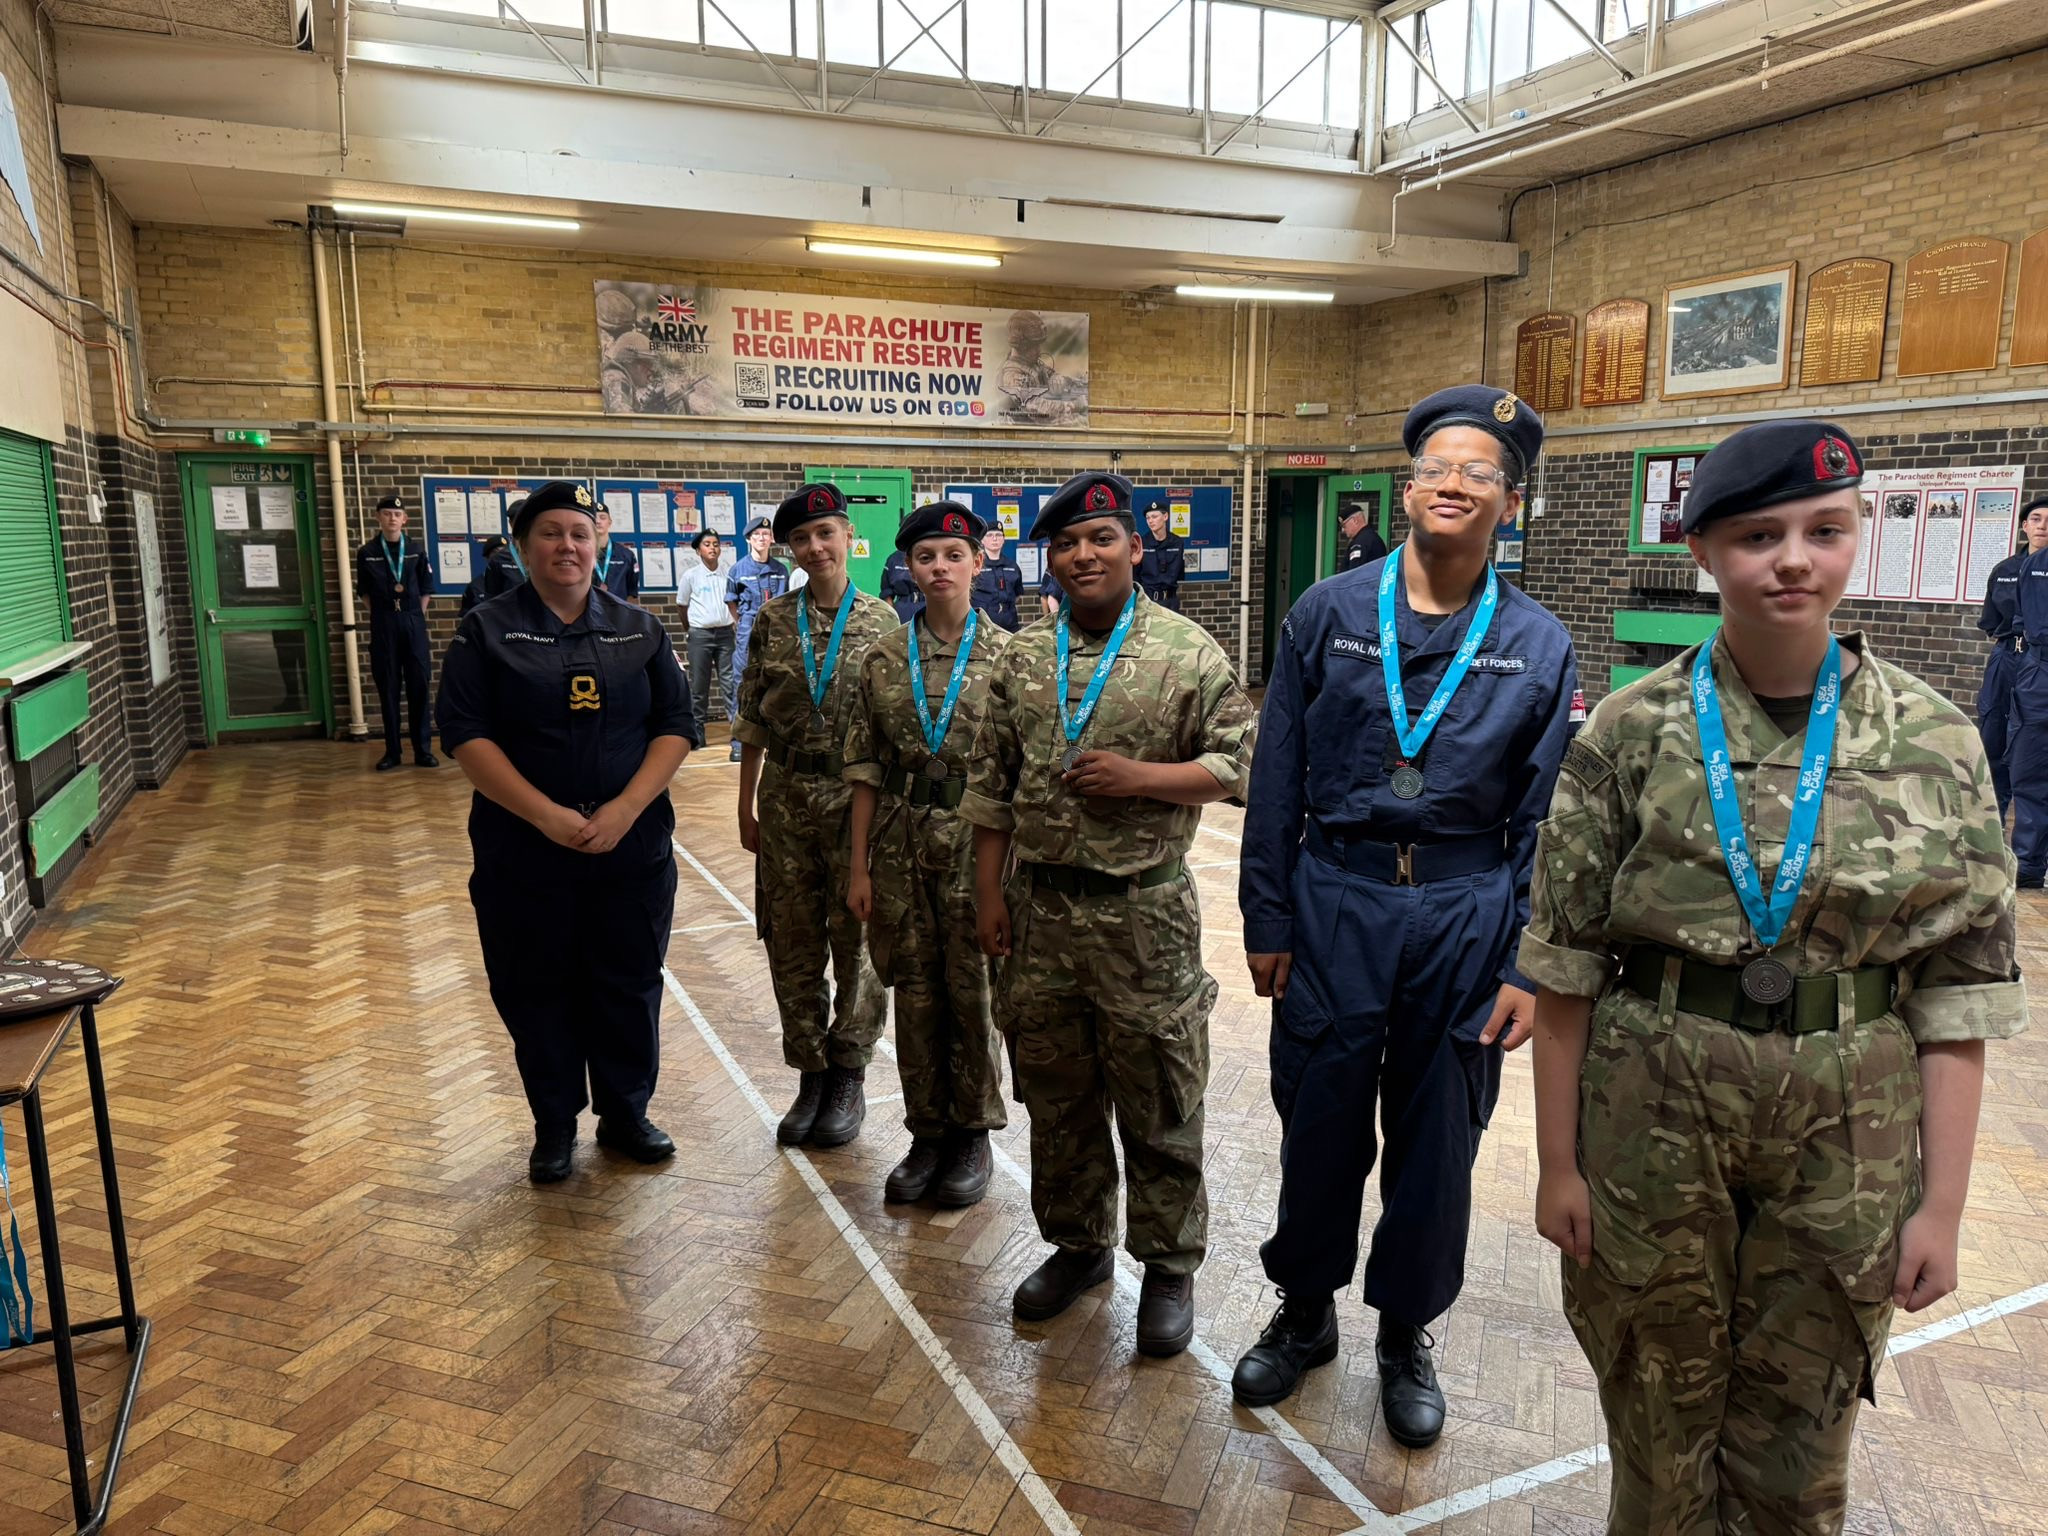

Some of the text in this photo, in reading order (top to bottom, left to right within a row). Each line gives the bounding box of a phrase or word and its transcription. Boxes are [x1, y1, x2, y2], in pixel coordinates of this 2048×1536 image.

[649, 321, 708, 343] ARMY
[731, 306, 983, 344] THE PARACHUTE
[649, 341, 709, 354] BE THE BEST
[732, 333, 983, 369] REGIMENT RESERVE
[774, 364, 983, 396] RECRUITING NOW
[775, 393, 932, 415] FOLLOW US ON
[233, 463, 256, 472] FIRE
[1288, 454, 1325, 465] NO EXIT
[234, 472, 256, 481] EXIT
[1878, 470, 2015, 481] The Parachute Regiment Charter
[506, 632, 533, 640] ROYAL
[1333, 638, 1367, 654] ROYAL
[1489, 658, 1523, 668] FORCES
[1695, 679, 1708, 715] CADETS
[1701, 678, 1711, 697] SEA
[1817, 681, 1827, 702] SEA
[1825, 671, 1838, 706] CADETS
[1709, 764, 1724, 800] CADETS
[1718, 762, 1729, 783] SEA
[1801, 767, 1813, 788] SEA
[1810, 753, 1825, 792] CADETS
[1736, 850, 1749, 870] SEA
[1781, 857, 1794, 878] SEA
[1790, 842, 1807, 881] CADETS
[1729, 852, 1748, 890] CADETS
